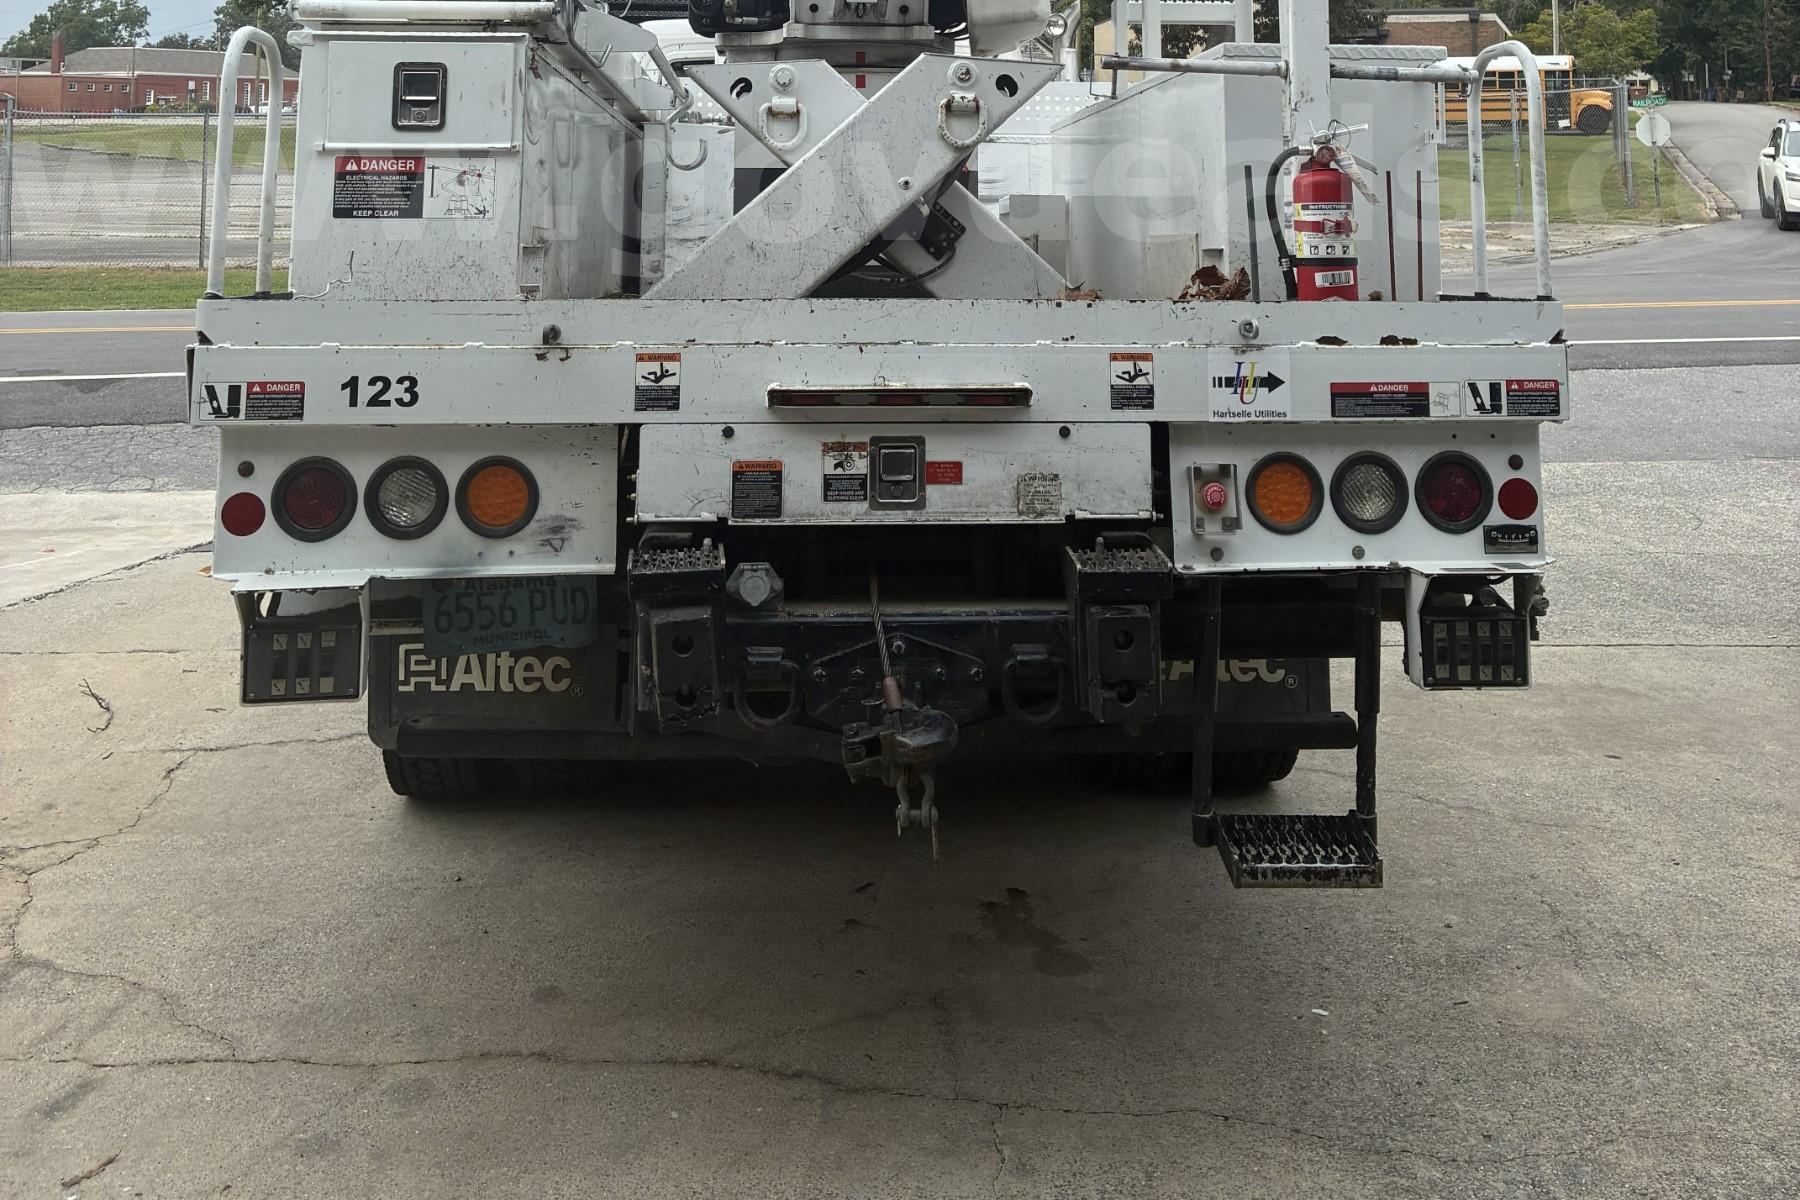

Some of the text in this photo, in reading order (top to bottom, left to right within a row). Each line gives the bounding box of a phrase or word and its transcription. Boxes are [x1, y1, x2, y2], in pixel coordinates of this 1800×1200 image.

[360, 159, 415, 171] DANGER
[266, 383, 301, 392] DANGER
[1378, 384, 1409, 392] DANGER
[1523, 381, 1555, 389] DANGER
[340, 375, 420, 408] 123
[1212, 409, 1287, 418] Hartselle Utilities
[744, 462, 777, 470] WARNING
[434, 586, 590, 634] 6556 PUD
[473, 631, 552, 645] MUNICIPAL
[449, 651, 572, 693] Altec
